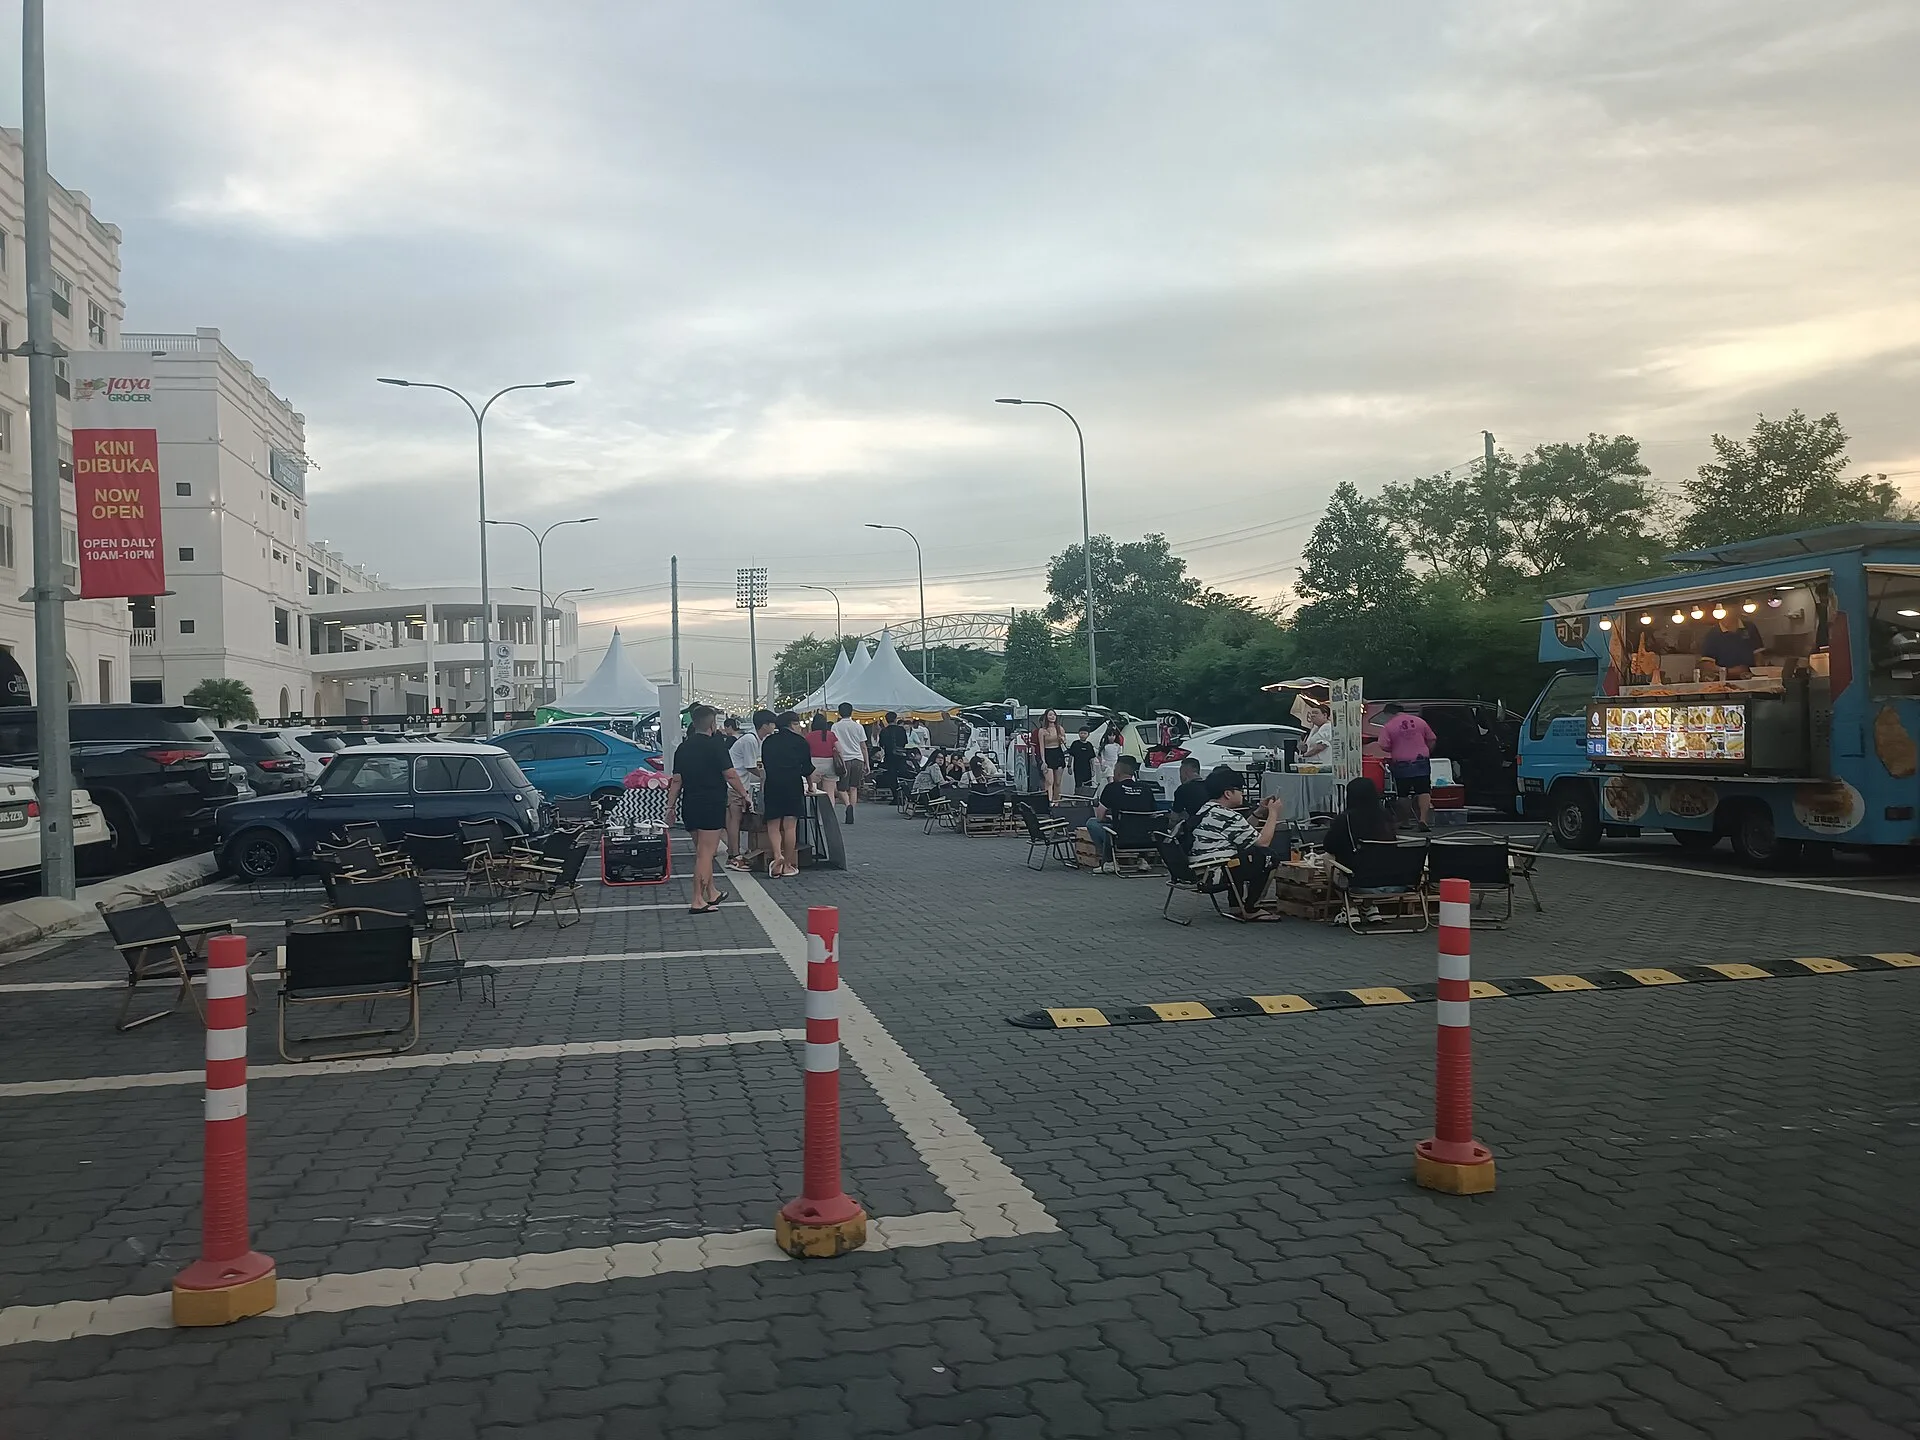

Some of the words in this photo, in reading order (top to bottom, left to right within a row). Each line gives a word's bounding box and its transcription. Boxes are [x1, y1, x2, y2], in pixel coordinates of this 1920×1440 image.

[108, 393, 152, 402] GROCER
[94, 440, 135, 455] KINI
[77, 458, 156, 474] DIBUKA
[94, 488, 140, 503] NOW
[91, 505, 144, 520] OPEN
[83, 538, 118, 549] OPEN
[121, 538, 157, 548] DAILY
[86, 549, 155, 561] 10AM-10PM
